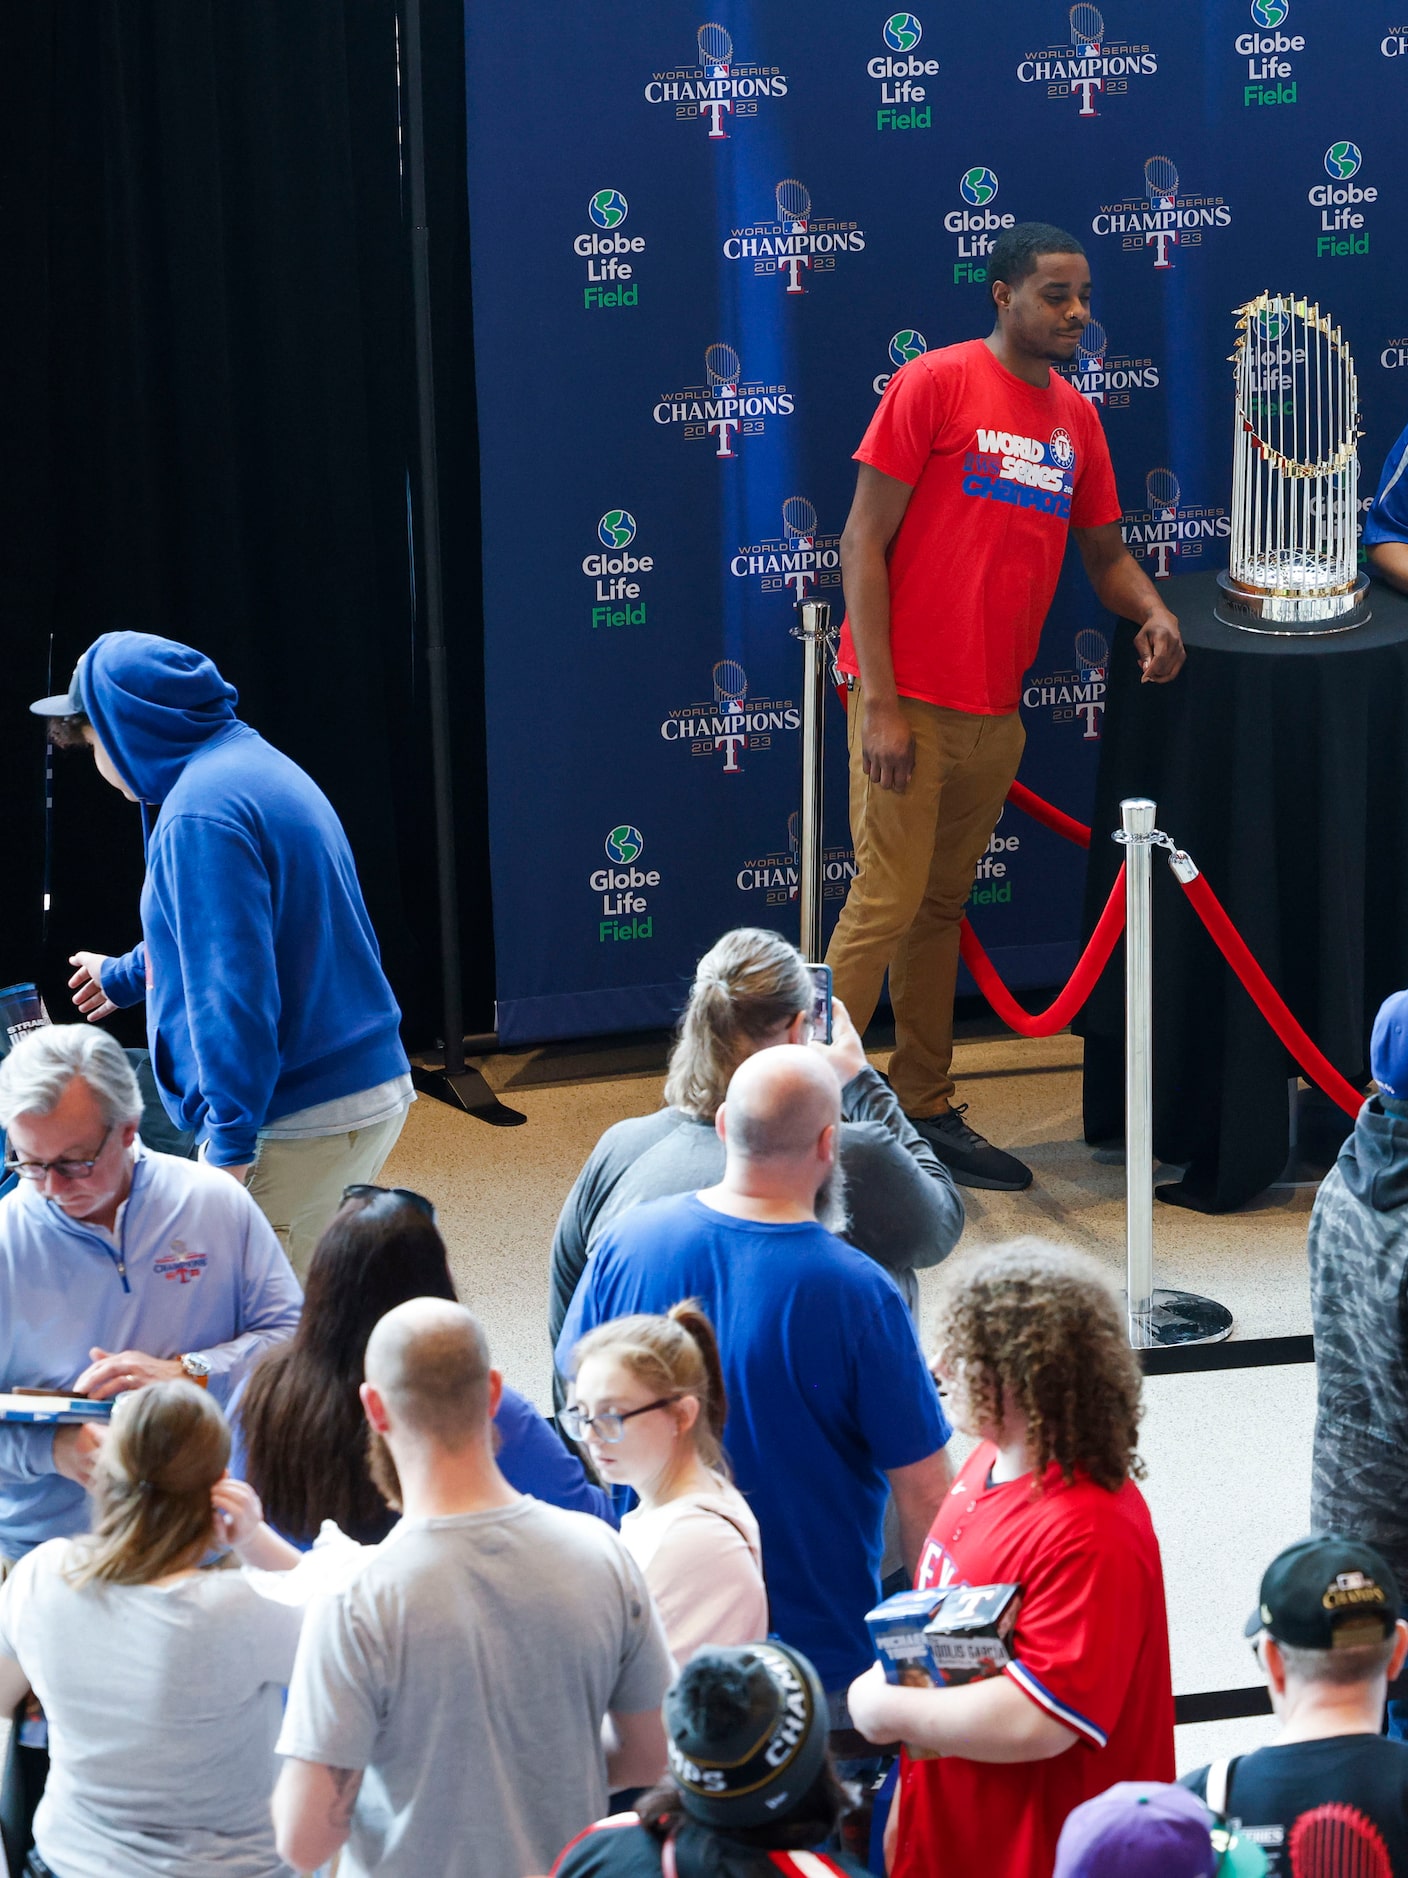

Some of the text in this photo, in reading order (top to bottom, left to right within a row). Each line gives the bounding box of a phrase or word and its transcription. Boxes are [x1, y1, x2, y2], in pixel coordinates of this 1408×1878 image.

[1025, 44, 1150, 60] WORLD SERIES
[1234, 31, 1306, 56] Globe
[652, 66, 780, 81] WORLD SERIES
[866, 55, 940, 79] Globe
[1016, 53, 1158, 83] CHAMPIONS
[1248, 56, 1292, 80] Life
[644, 75, 788, 104] CHAMPIONS
[881, 81, 926, 104] Life
[1047, 78, 1128, 117] 20 T 23
[1243, 82, 1297, 107] Field
[675, 99, 758, 139] 20 T 23
[876, 106, 932, 131] Field
[1100, 197, 1224, 213] WORLD SERIES
[1308, 183, 1378, 207] Globe
[731, 221, 858, 237] WORLD SERIES
[943, 209, 1016, 233] Globe
[1091, 206, 1232, 235] CHAMPIONS
[1321, 207, 1365, 231] Life
[573, 232, 646, 257] Globe
[722, 231, 866, 260] CHAMPIONS
[1122, 231, 1202, 269] 20 T 23
[1316, 232, 1370, 258] Field
[587, 257, 633, 282] Life
[754, 255, 836, 295] 20 T 23
[953, 263, 987, 285] Fie
[583, 284, 639, 310] Field
[1052, 359, 1152, 374] RLD SERIES
[1070, 367, 1160, 391] MPIONS
[661, 385, 787, 401] WORLD SERIES
[1109, 394, 1130, 405] 23
[653, 394, 795, 424] CHAMPIONS
[684, 419, 765, 459] 20 T 23
[976, 429, 1045, 463] WORLD
[999, 455, 1066, 492] SERIES
[1120, 508, 1225, 524] RLD SERIES
[1121, 516, 1232, 544] AMPIONS
[738, 539, 840, 554] WORLD SER
[582, 552, 654, 577] Globe
[730, 549, 840, 577] CHAMPIO
[1146, 541, 1181, 581] T
[1181, 544, 1203, 554] 23
[596, 577, 641, 601] Life
[761, 571, 841, 609] 20 T 23
[592, 602, 646, 629] Field
[1030, 673, 1080, 686] WORLD
[1022, 683, 1107, 708] CHAMP
[668, 700, 793, 718] WORLD SERIES
[1052, 701, 1105, 741] 20 T
[660, 708, 800, 741] CHAMPIONS
[691, 733, 771, 774] 20 T 23
[744, 851, 856, 868] WORLD ERIE
[974, 857, 1007, 880] ife
[589, 867, 661, 892] Globe
[736, 860, 858, 891] CHAMON
[602, 891, 648, 916] Life
[766, 891, 788, 903] 20
[823, 885, 845, 896] 23
[971, 881, 1012, 906] ield
[599, 916, 653, 943] Field
[956, 1588, 996, 1618] T
